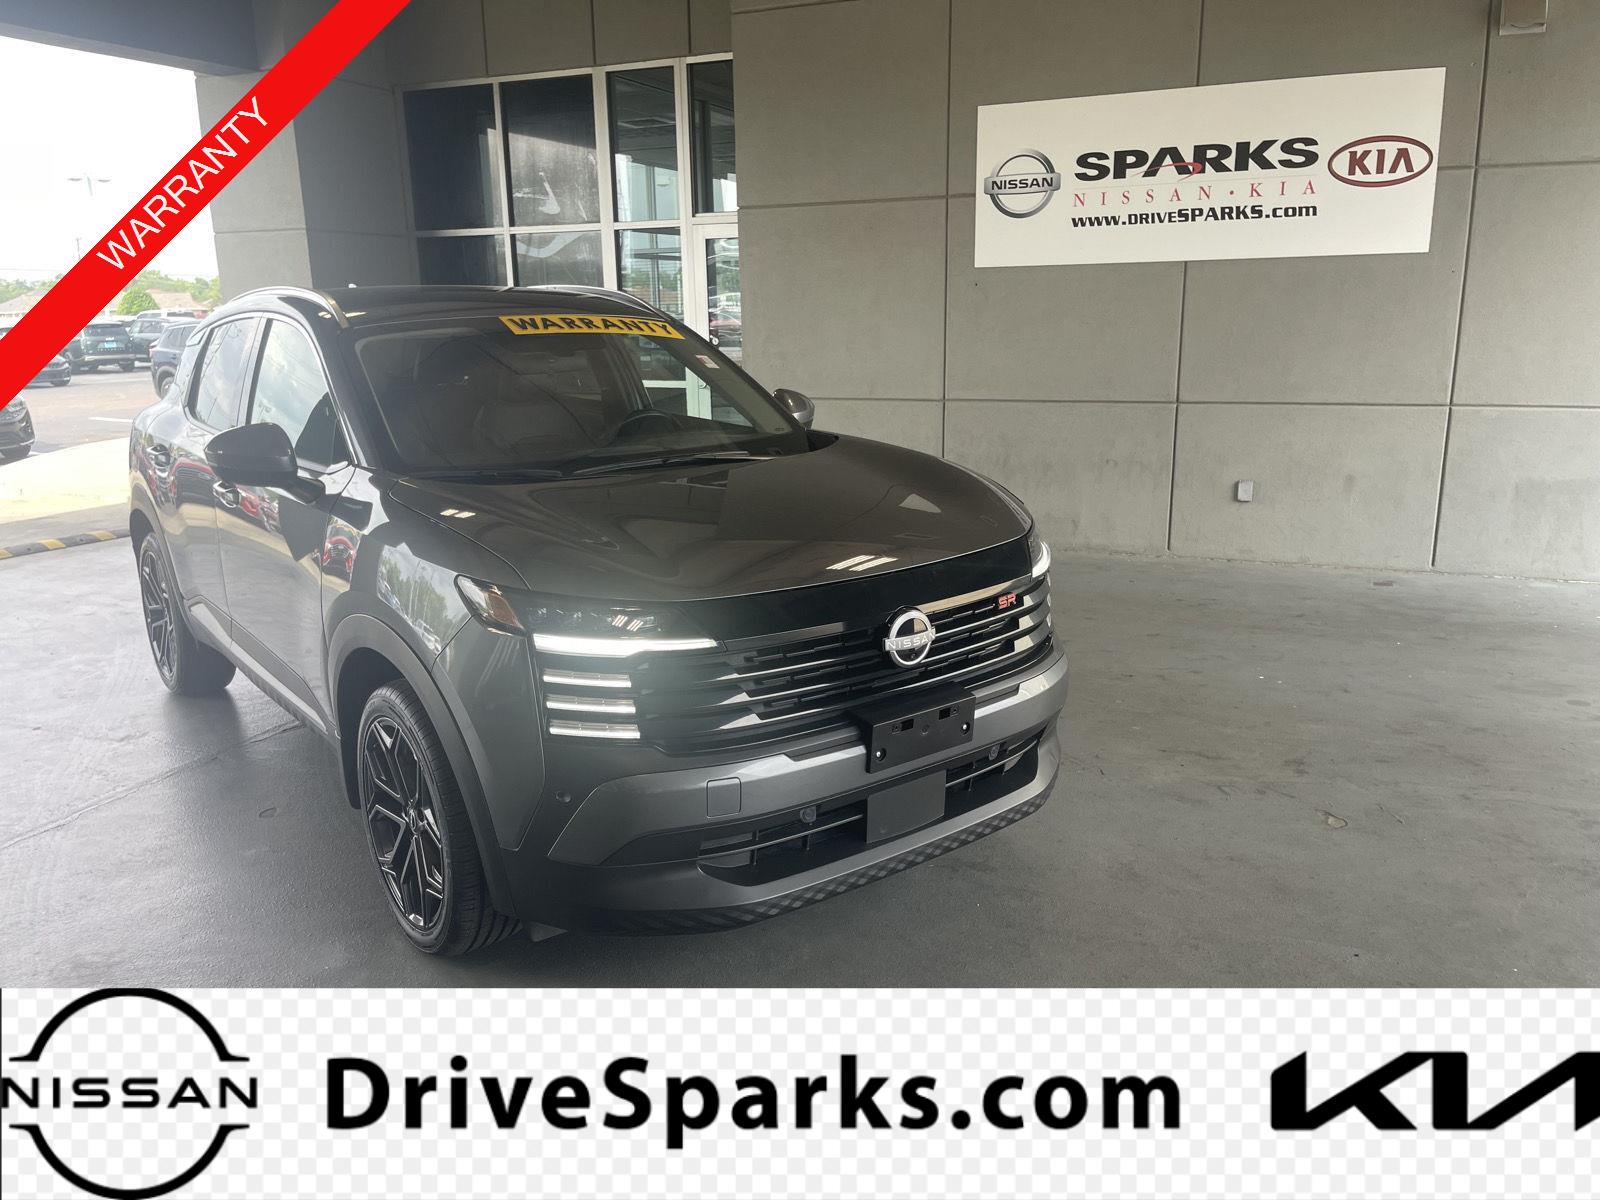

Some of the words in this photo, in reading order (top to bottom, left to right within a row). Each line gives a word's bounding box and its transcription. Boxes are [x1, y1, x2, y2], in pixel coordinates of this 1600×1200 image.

[1074, 137, 1319, 182] SPARKS
[1347, 147, 1416, 176] KIA
[990, 177, 1054, 191] NISSAN
[1072, 186, 1212, 208] NISSAN
[1248, 179, 1317, 198] KIA
[1071, 204, 1318, 228] www.DRIVESPARKS.com
[508, 317, 674, 335] WARRANTY
[998, 593, 1017, 609] SR
[886, 630, 935, 650] NISSAN
